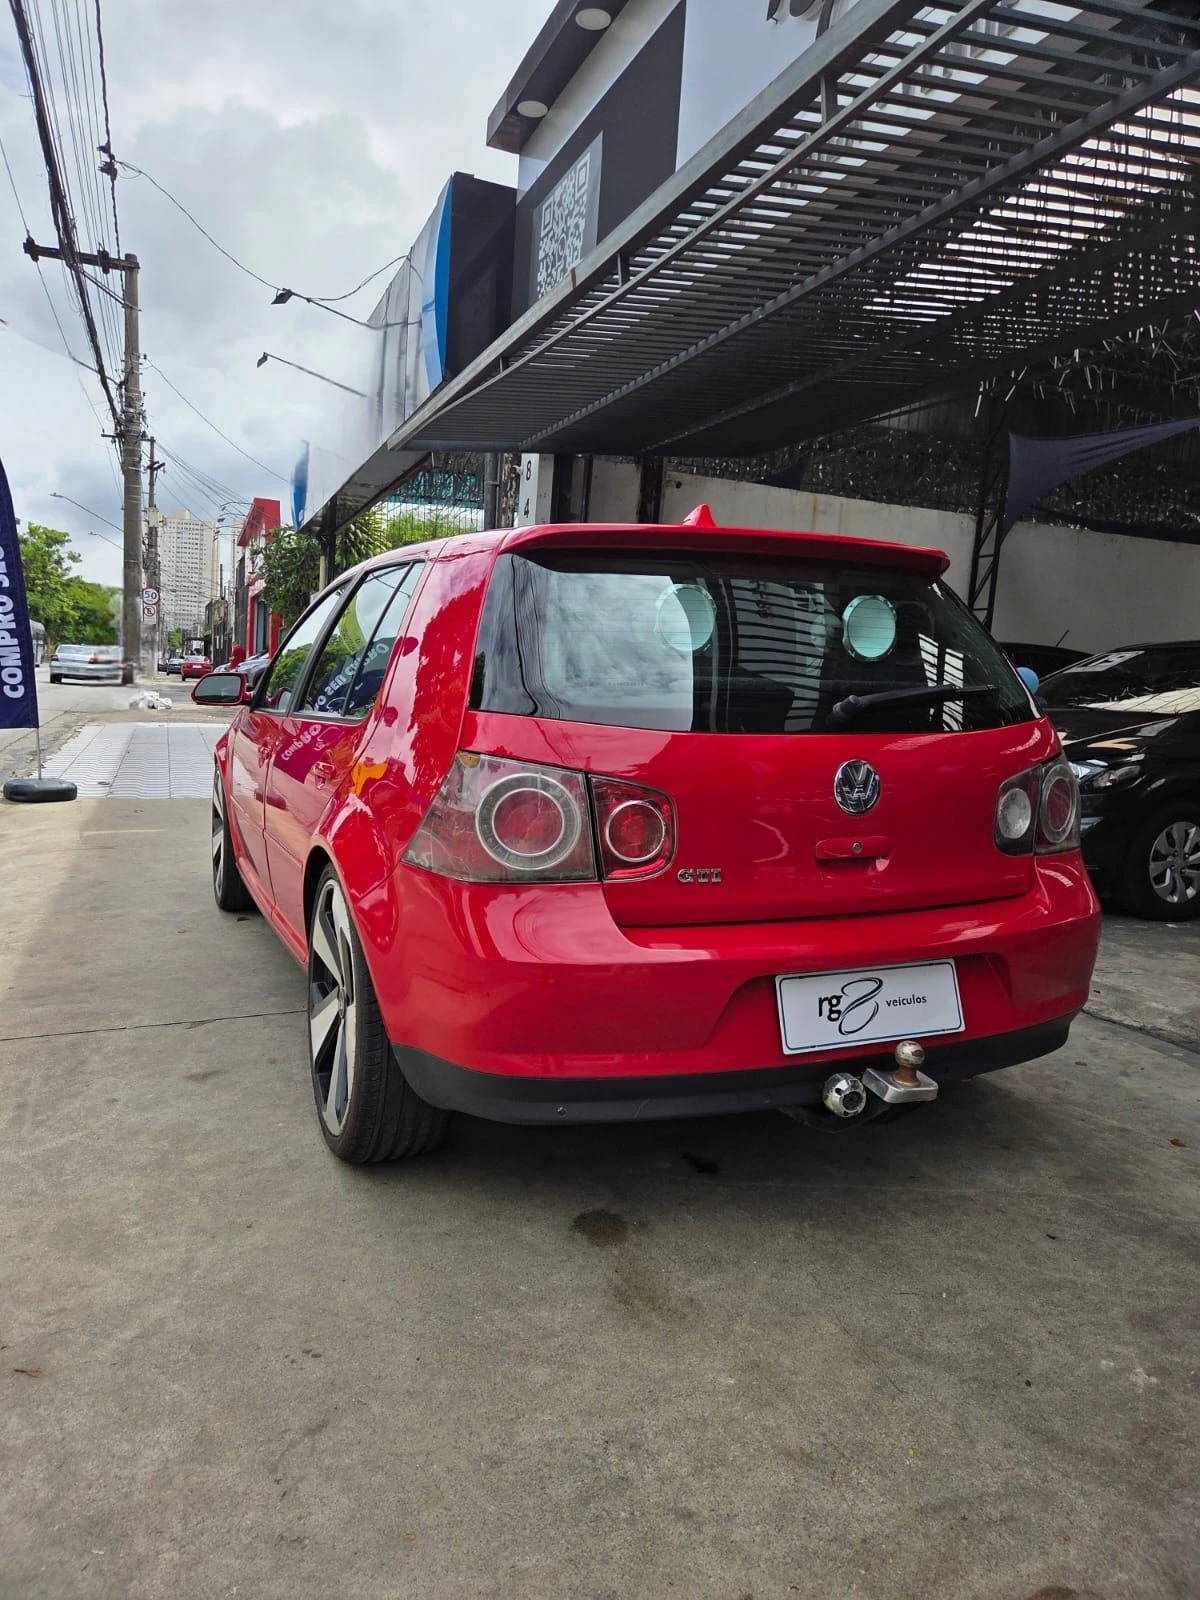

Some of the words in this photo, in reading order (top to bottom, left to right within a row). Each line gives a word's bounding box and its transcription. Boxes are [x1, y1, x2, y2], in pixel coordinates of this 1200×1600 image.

[144, 590, 157, 600] 50
[0, 592, 25, 700] COMPRO
[677, 868, 721, 882] GTI
